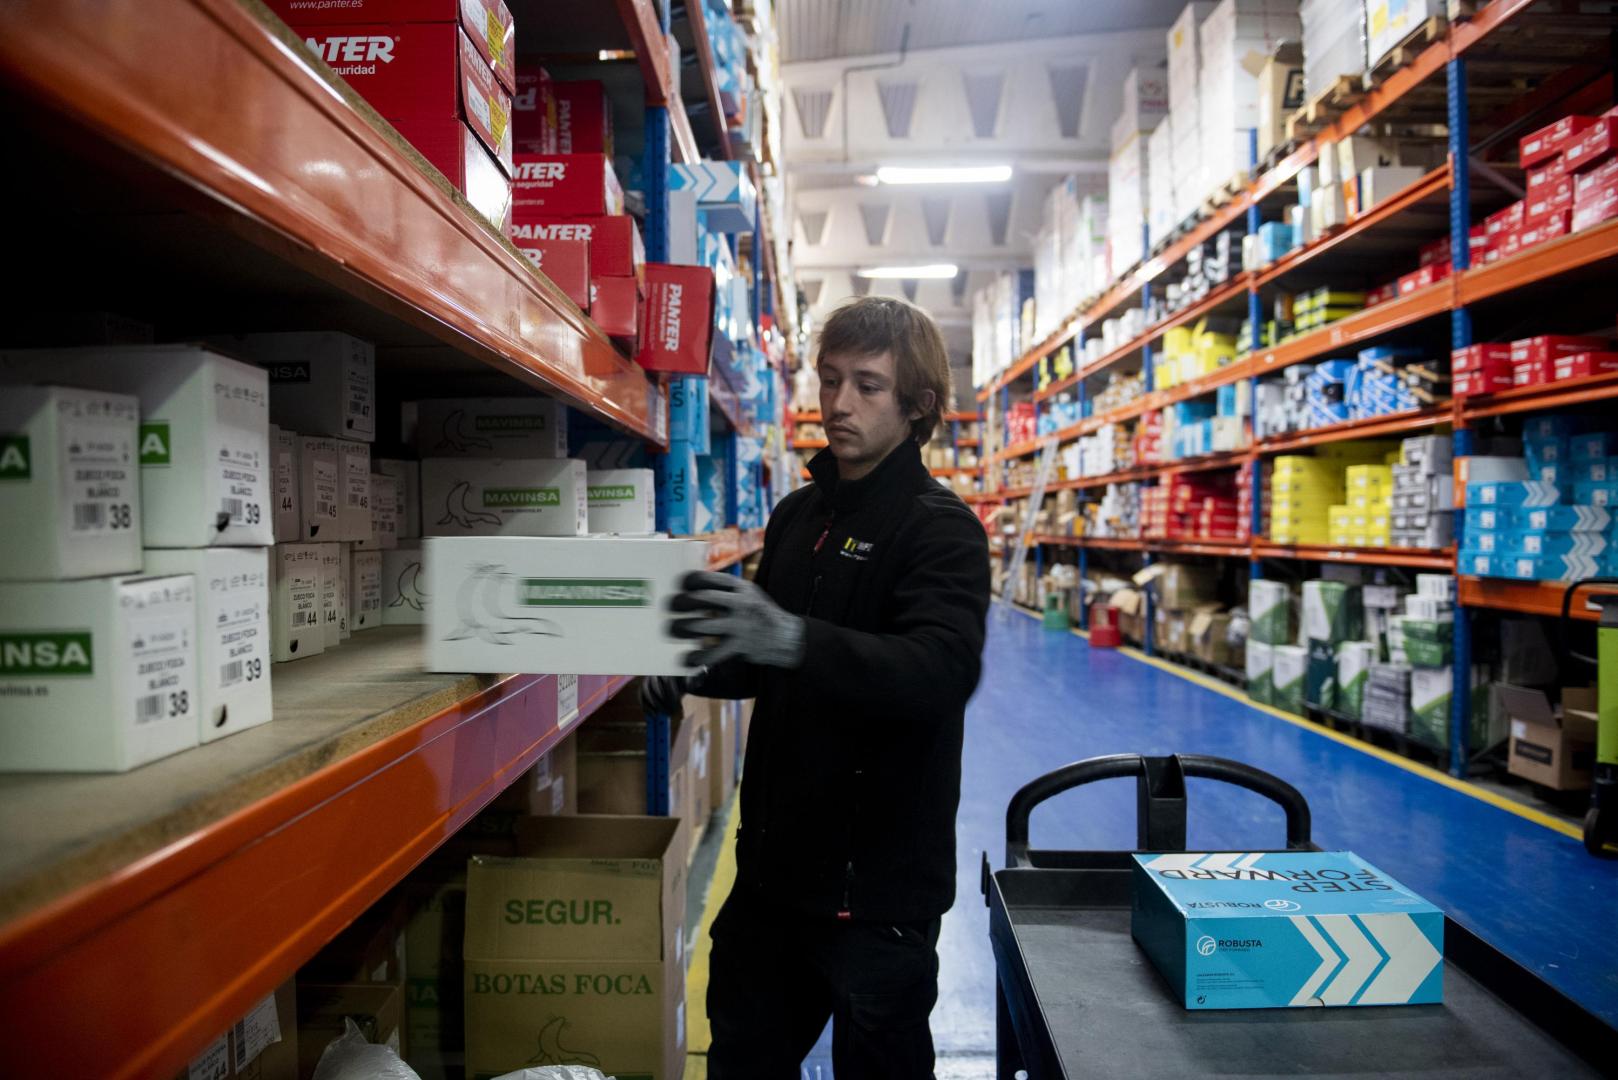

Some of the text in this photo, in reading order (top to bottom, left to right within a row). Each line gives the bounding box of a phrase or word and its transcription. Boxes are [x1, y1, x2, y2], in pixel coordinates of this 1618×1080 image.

[304, 36, 395, 64] NTER
[511, 162, 566, 180] NTER
[665, 283, 682, 351] PANTER
[484, 490, 559, 503] MAVINSA
[587, 487, 634, 498] AVINSA
[109, 503, 131, 529] 38
[246, 503, 260, 525] 39
[307, 611, 317, 626] 44
[246, 658, 262, 682] 39
[169, 690, 189, 717] 38
[1159, 868, 1378, 881] FORWARD
[1291, 879, 1393, 894] STEP
[504, 899, 621, 925] SEGUR.
[1187, 902, 1263, 911] ROBUSTA
[1218, 939, 1262, 948] ROBUSTA
[473, 973, 653, 996] BOTAS FOCA
